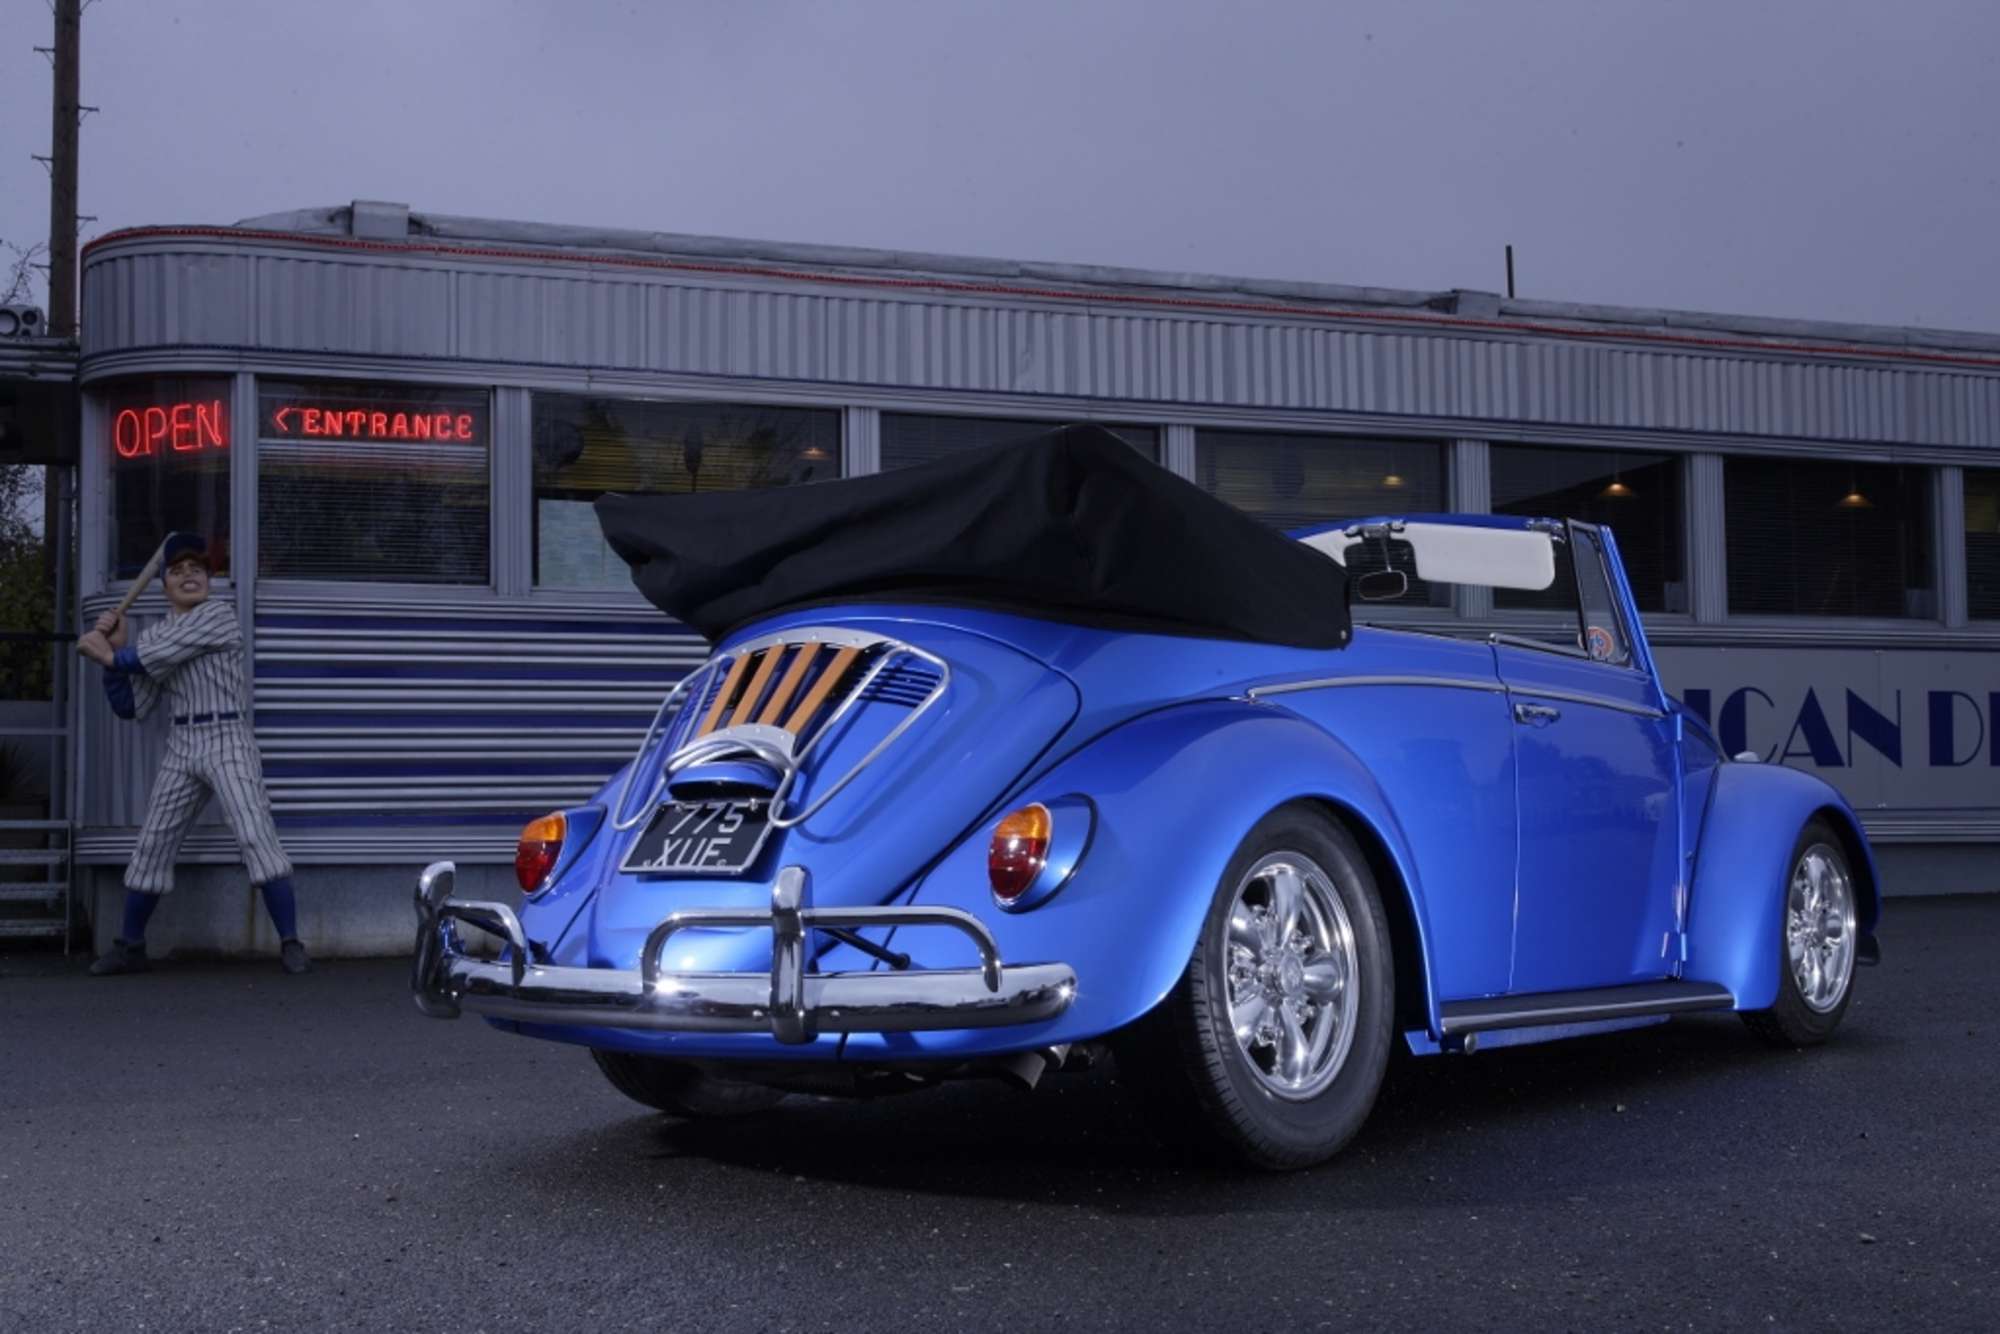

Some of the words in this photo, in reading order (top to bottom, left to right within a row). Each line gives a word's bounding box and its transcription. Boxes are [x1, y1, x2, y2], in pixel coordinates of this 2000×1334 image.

[116, 400, 222, 457] OPEN
[303, 408, 473, 439] ENTRANCE
[1683, 686, 1902, 768] CAN
[669, 802, 749, 835] 775
[652, 838, 732, 868] XUF
